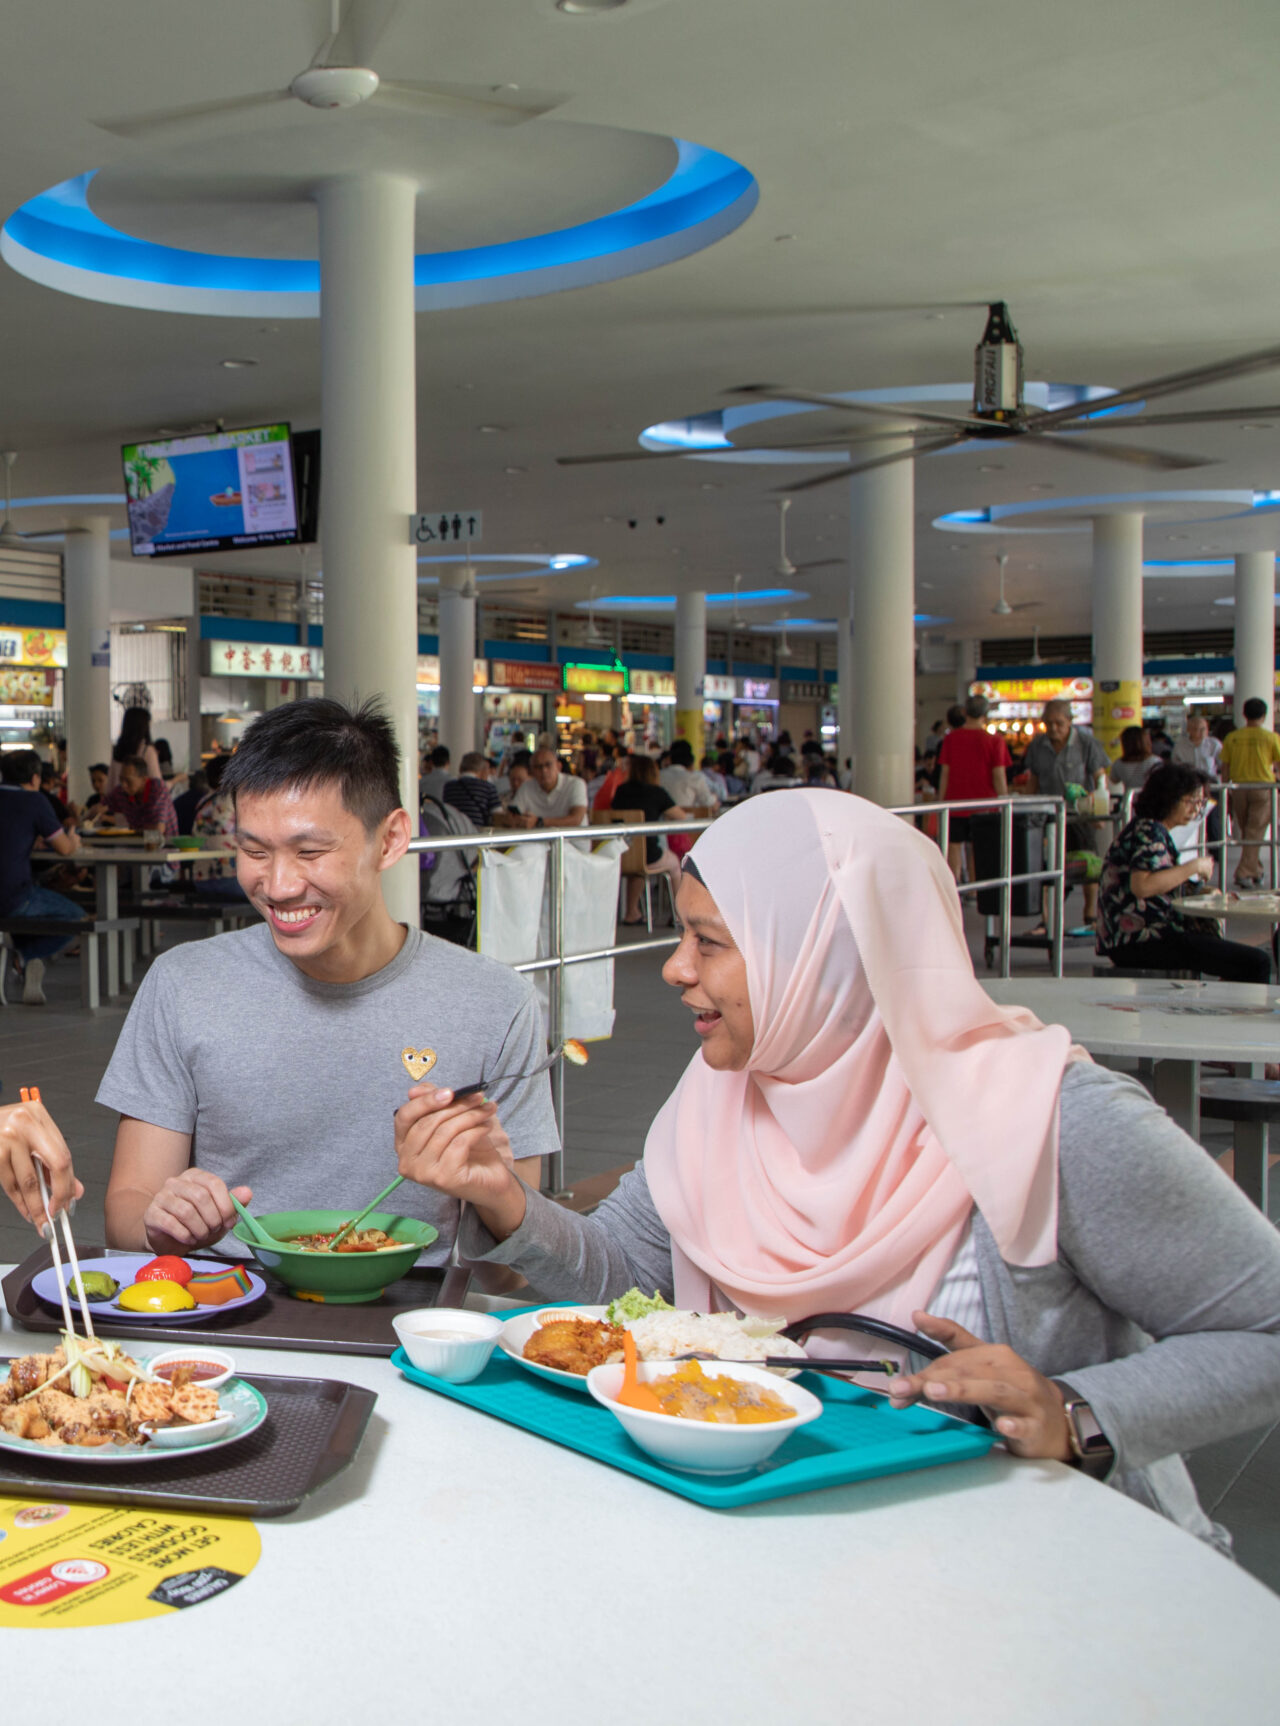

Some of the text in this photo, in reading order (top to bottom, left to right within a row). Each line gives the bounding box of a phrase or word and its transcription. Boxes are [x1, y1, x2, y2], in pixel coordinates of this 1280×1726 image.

[89, 1518, 157, 1549] CALORIES
[108, 1524, 180, 1555] WITH LESS
[128, 1525, 207, 1562] GOODNESS
[148, 1534, 220, 1568] GET MORE
